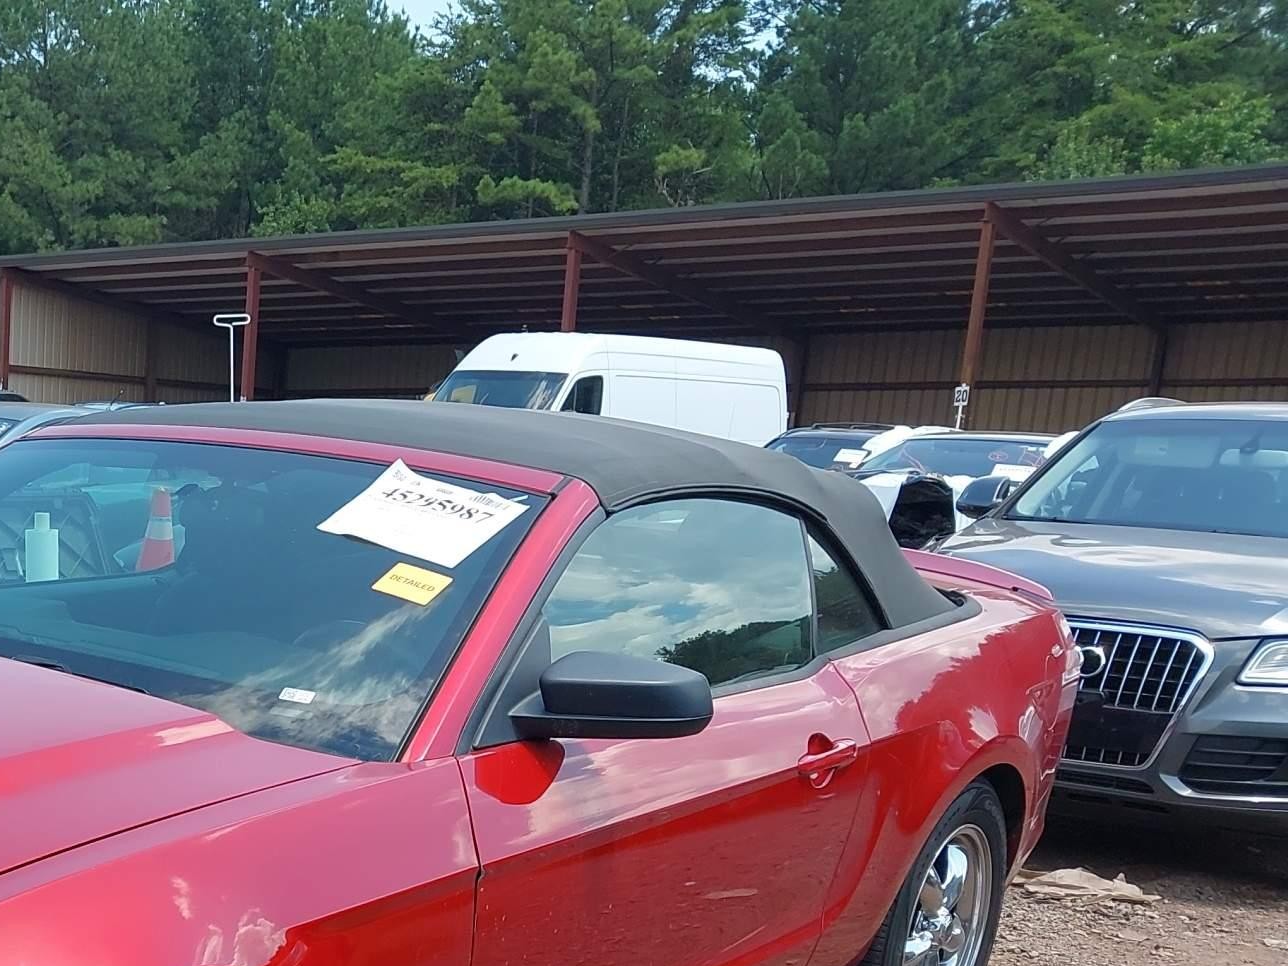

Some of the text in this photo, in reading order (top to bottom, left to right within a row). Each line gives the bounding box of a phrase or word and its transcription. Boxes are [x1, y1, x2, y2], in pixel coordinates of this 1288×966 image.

[955, 389, 968, 402] 20
[382, 487, 496, 524] 45295987
[388, 573, 436, 592] DETAILED
